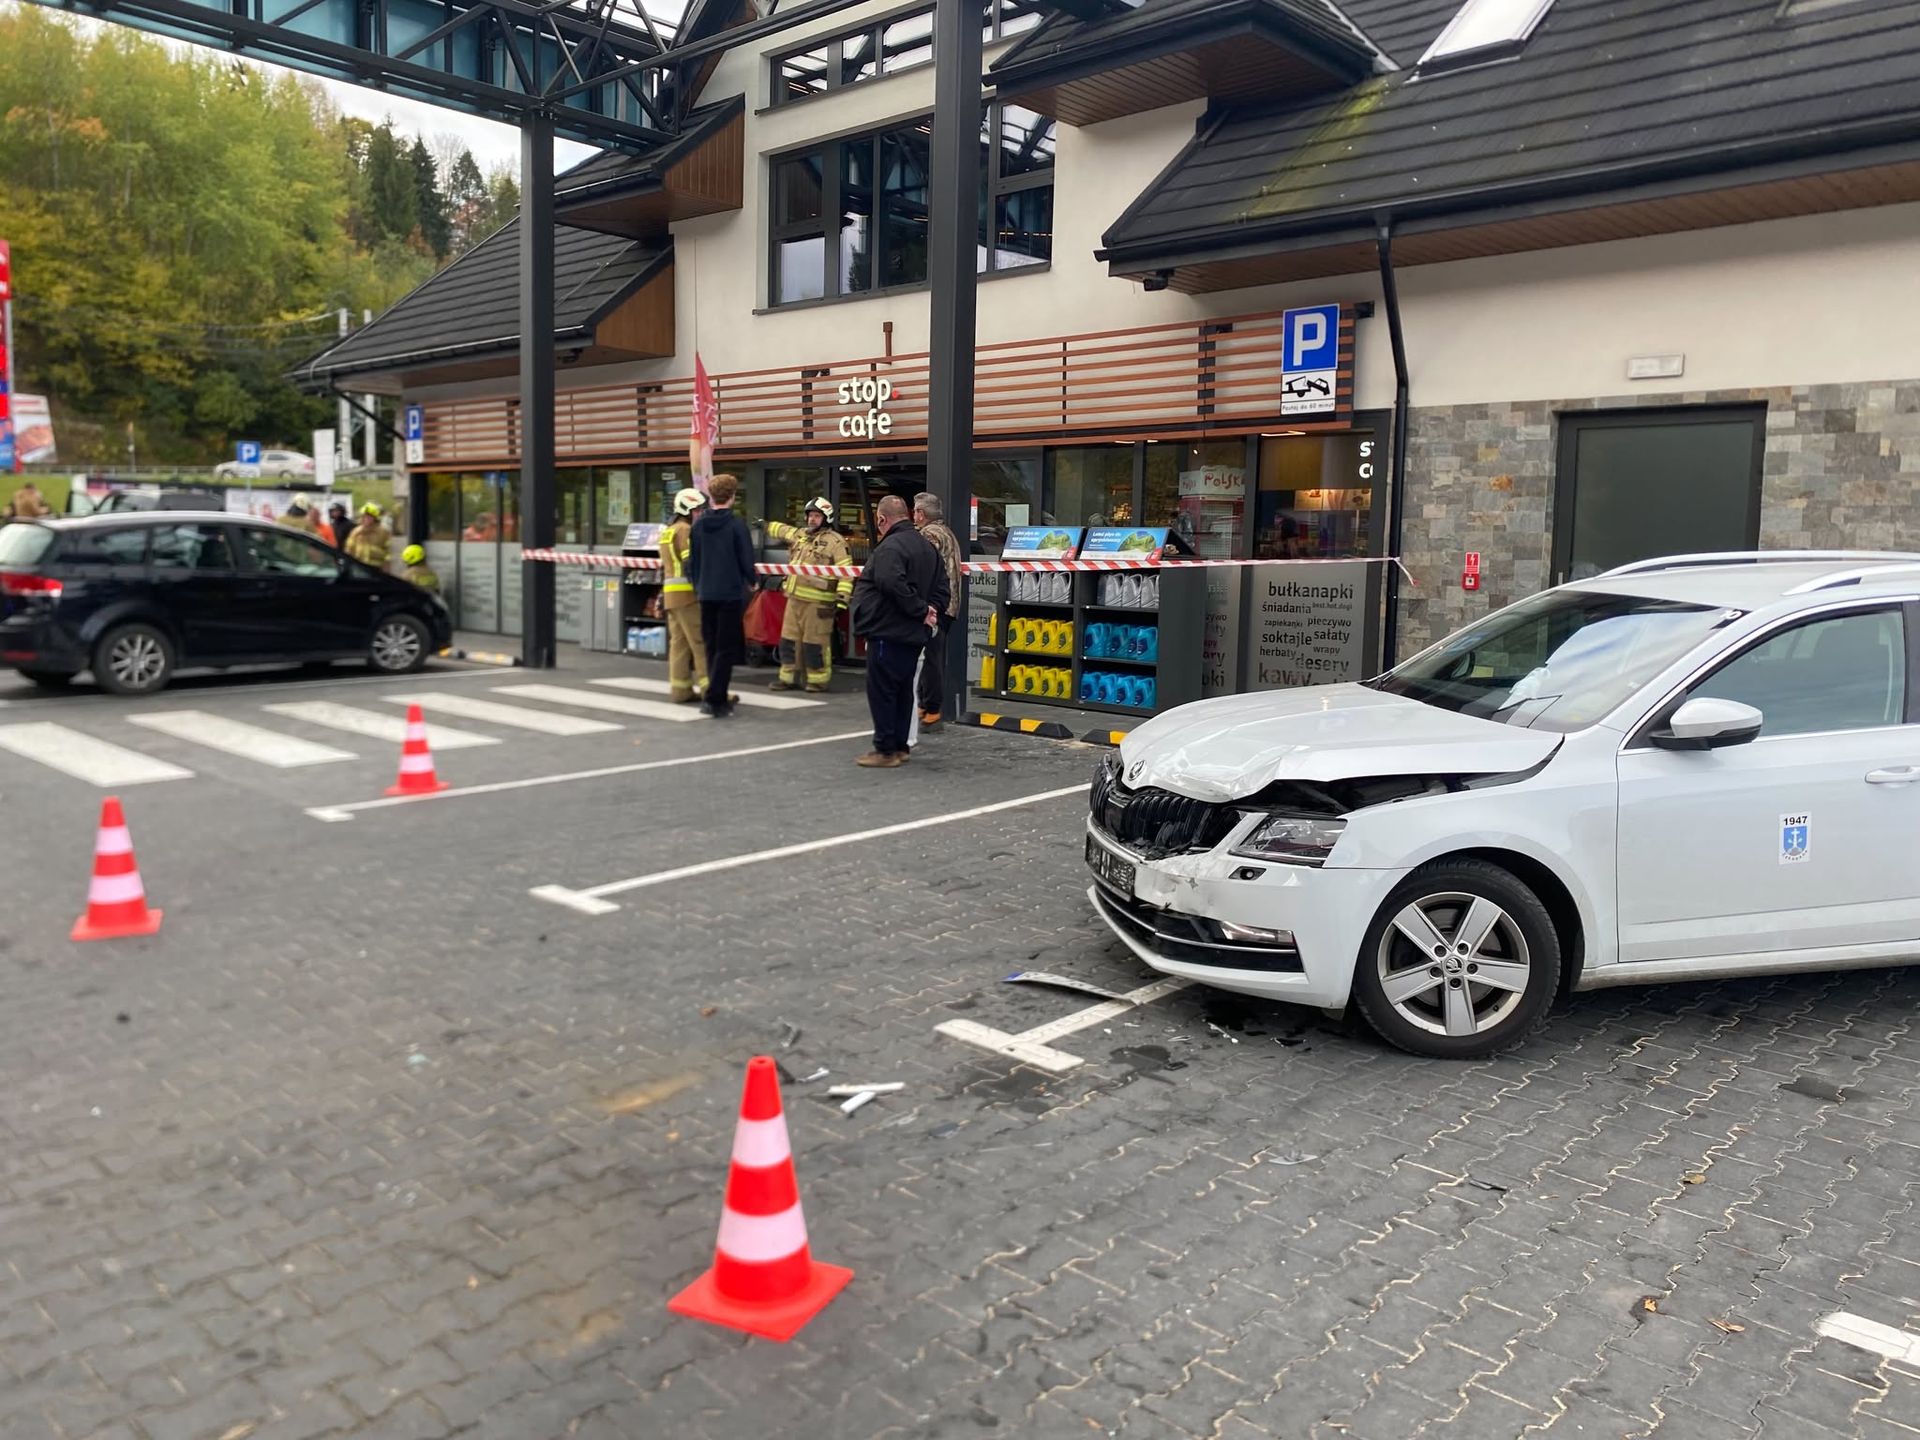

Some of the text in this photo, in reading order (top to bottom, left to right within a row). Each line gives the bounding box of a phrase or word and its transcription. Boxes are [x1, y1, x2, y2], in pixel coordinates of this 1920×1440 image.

[1293, 312, 1327, 367] P
[407, 405, 420, 439] P
[838, 408, 892, 440] cafe
[1268, 581, 1354, 602] bułkanapki
[1262, 601, 1312, 614] śniadania
[1264, 619, 1303, 628] zapiekanki
[1307, 616, 1352, 629] pieczywo
[1262, 631, 1313, 648] soktajle
[1314, 629, 1350, 644] sałaty
[1260, 646, 1297, 661] herbaty
[1313, 646, 1341, 657] wrapy
[1296, 653, 1350, 673] desery
[1258, 662, 1312, 687] kawy
[1783, 815, 1808, 826] 1947
